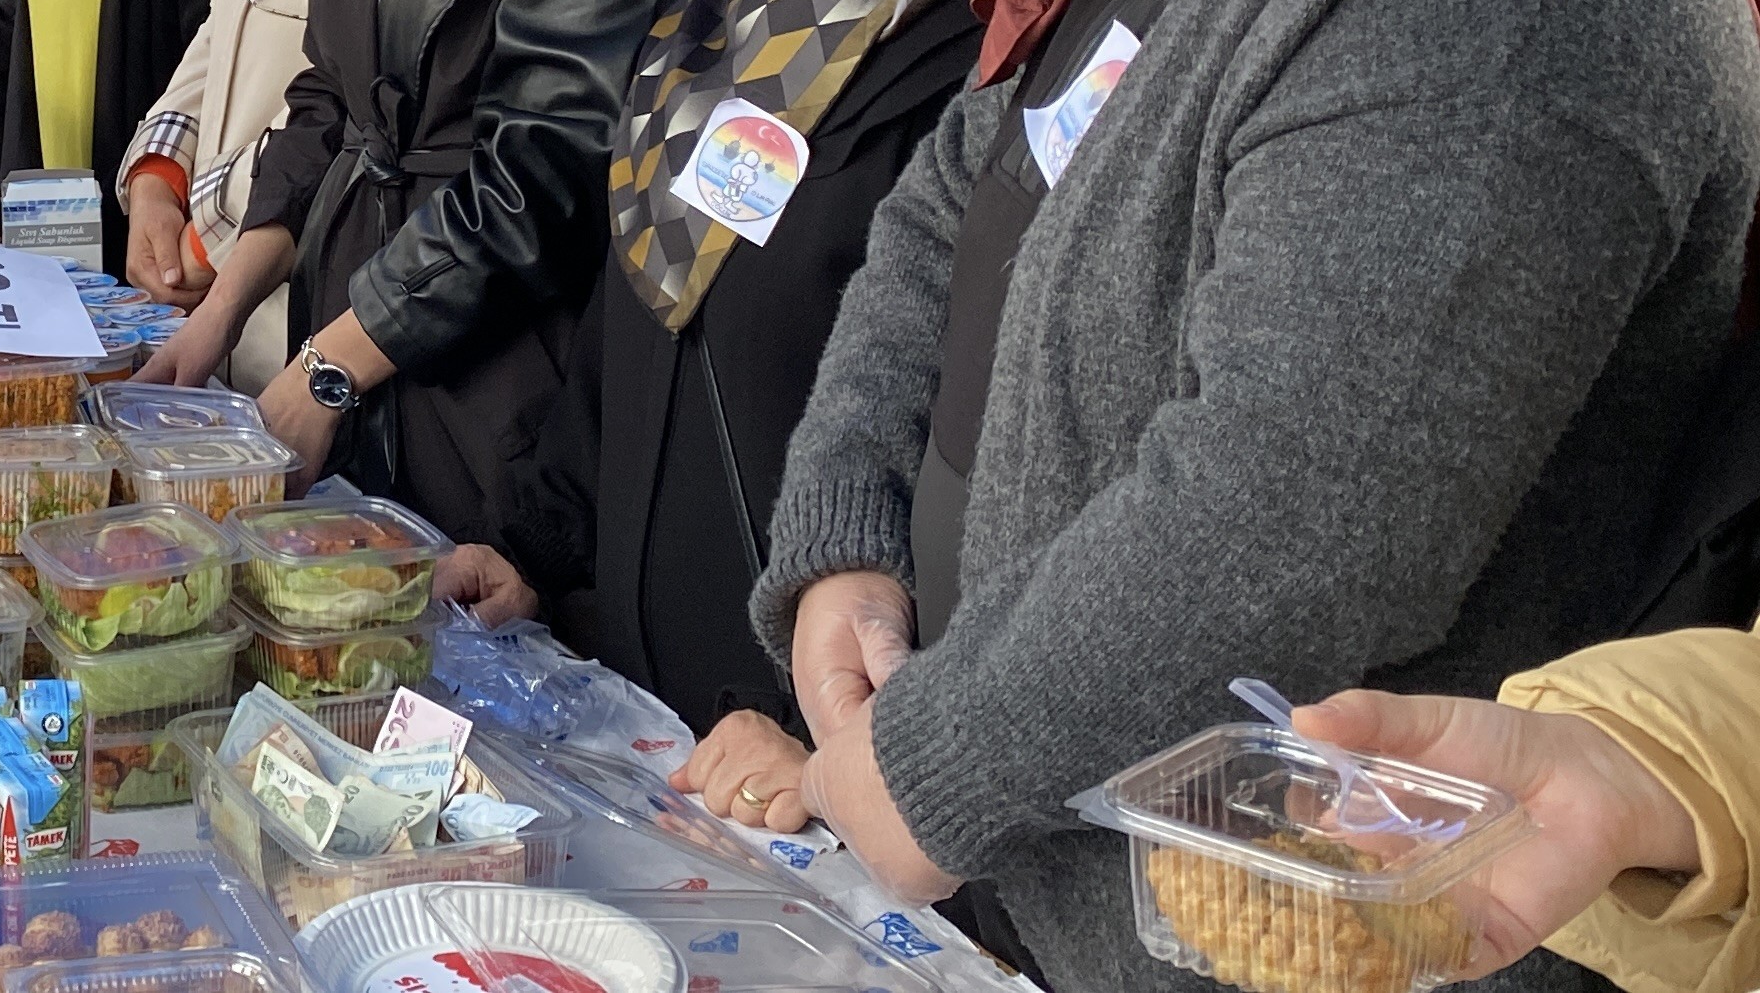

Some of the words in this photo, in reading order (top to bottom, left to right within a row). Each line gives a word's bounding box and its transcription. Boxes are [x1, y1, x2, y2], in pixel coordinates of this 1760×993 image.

[39, 225, 85, 237] Sabunluk
[424, 760, 450, 777] 100
[26, 831, 65, 846] TAMEK
